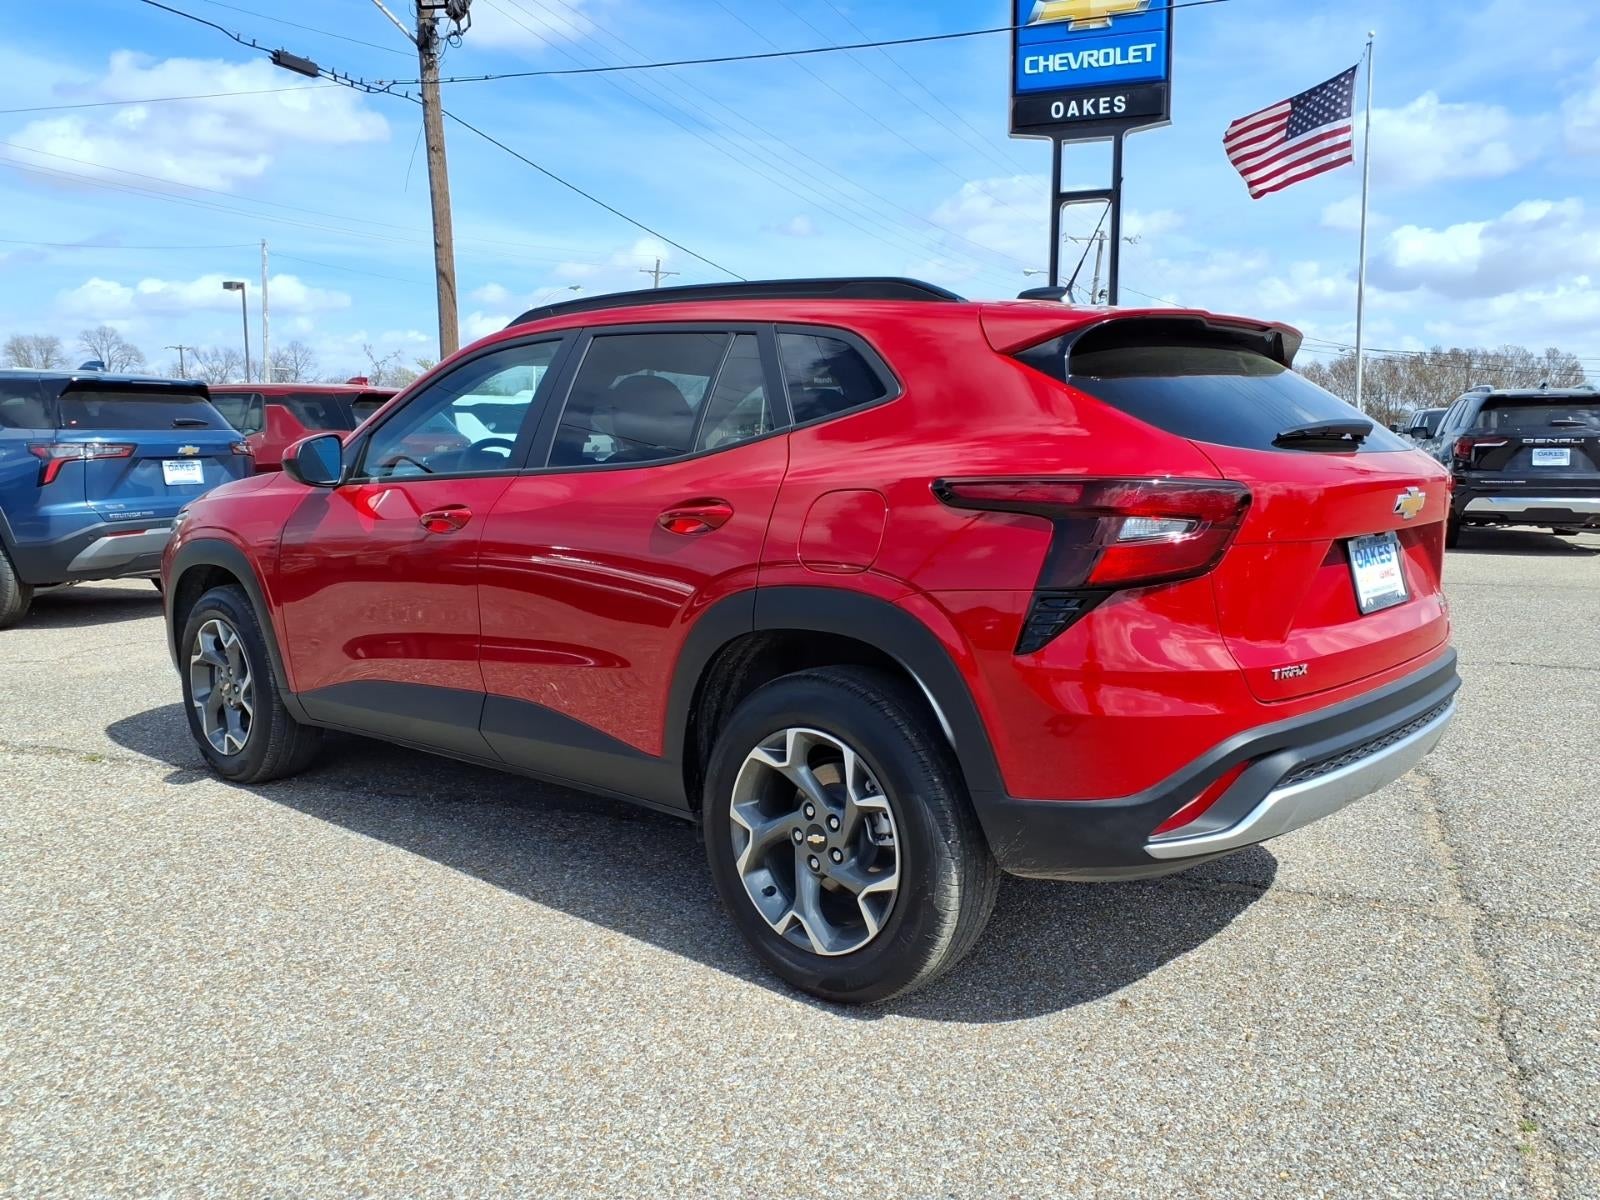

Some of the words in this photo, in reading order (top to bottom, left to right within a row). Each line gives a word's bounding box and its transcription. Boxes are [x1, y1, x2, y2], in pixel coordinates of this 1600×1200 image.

[1024, 43, 1157, 75] CHEVROLET
[1051, 95, 1126, 119] OAKES
[1354, 543, 1392, 569] OAKES
[1271, 663, 1308, 681] TRAX
